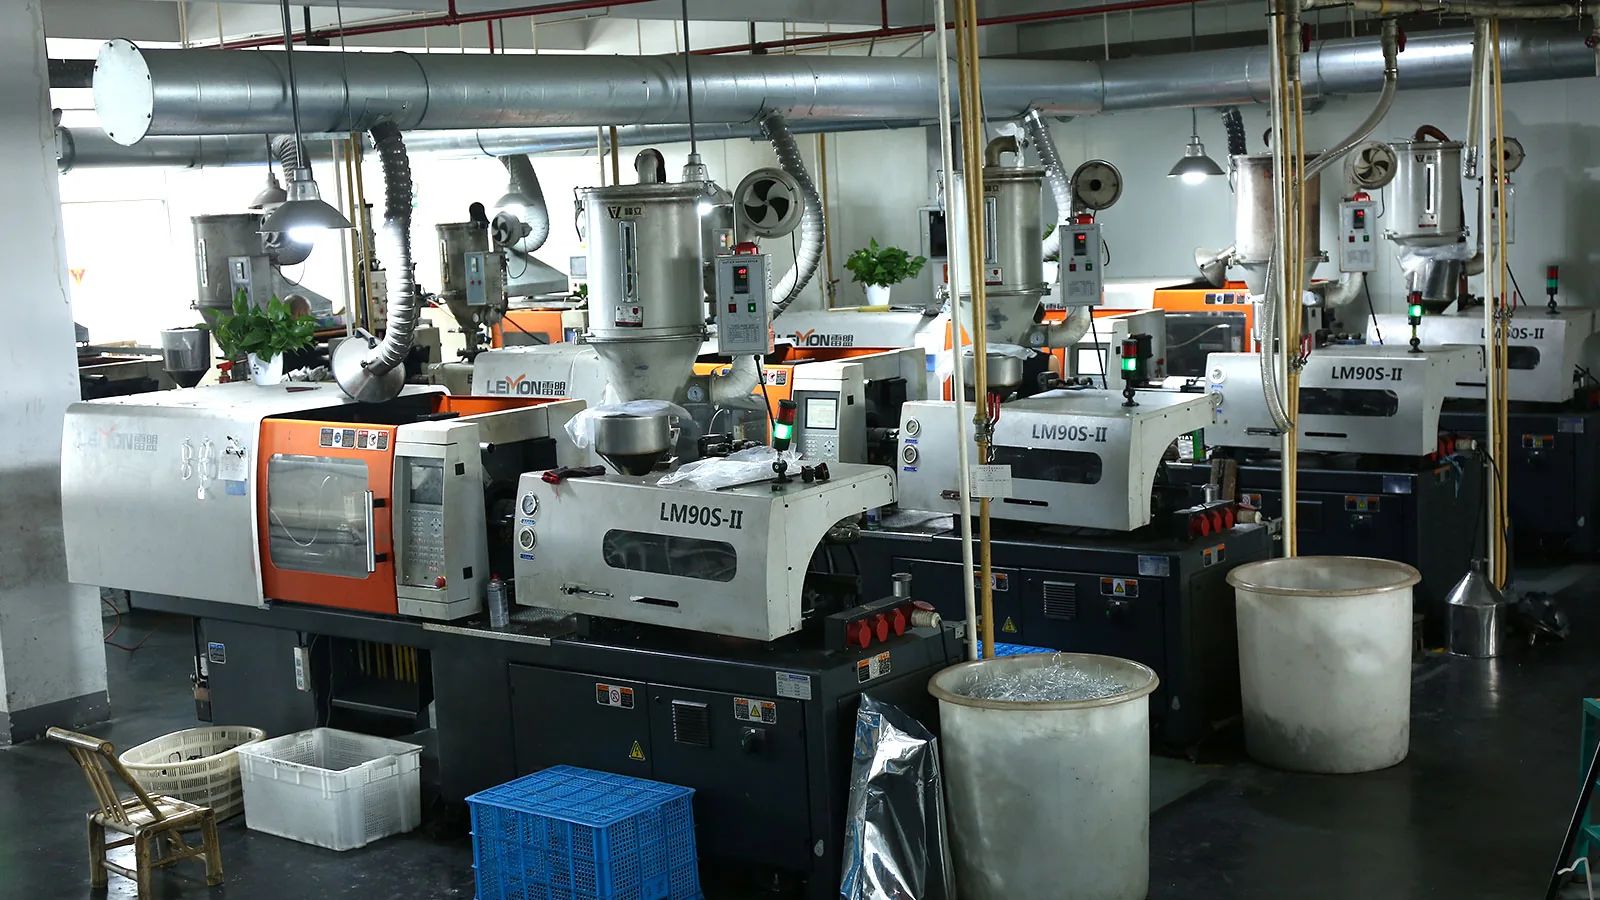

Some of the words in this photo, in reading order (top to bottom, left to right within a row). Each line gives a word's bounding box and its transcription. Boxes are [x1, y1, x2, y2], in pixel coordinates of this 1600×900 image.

[1331, 365, 1403, 382] LM90S-II
[1032, 423, 1108, 443] LM90S-II
[660, 502, 744, 530] LM90S-II
